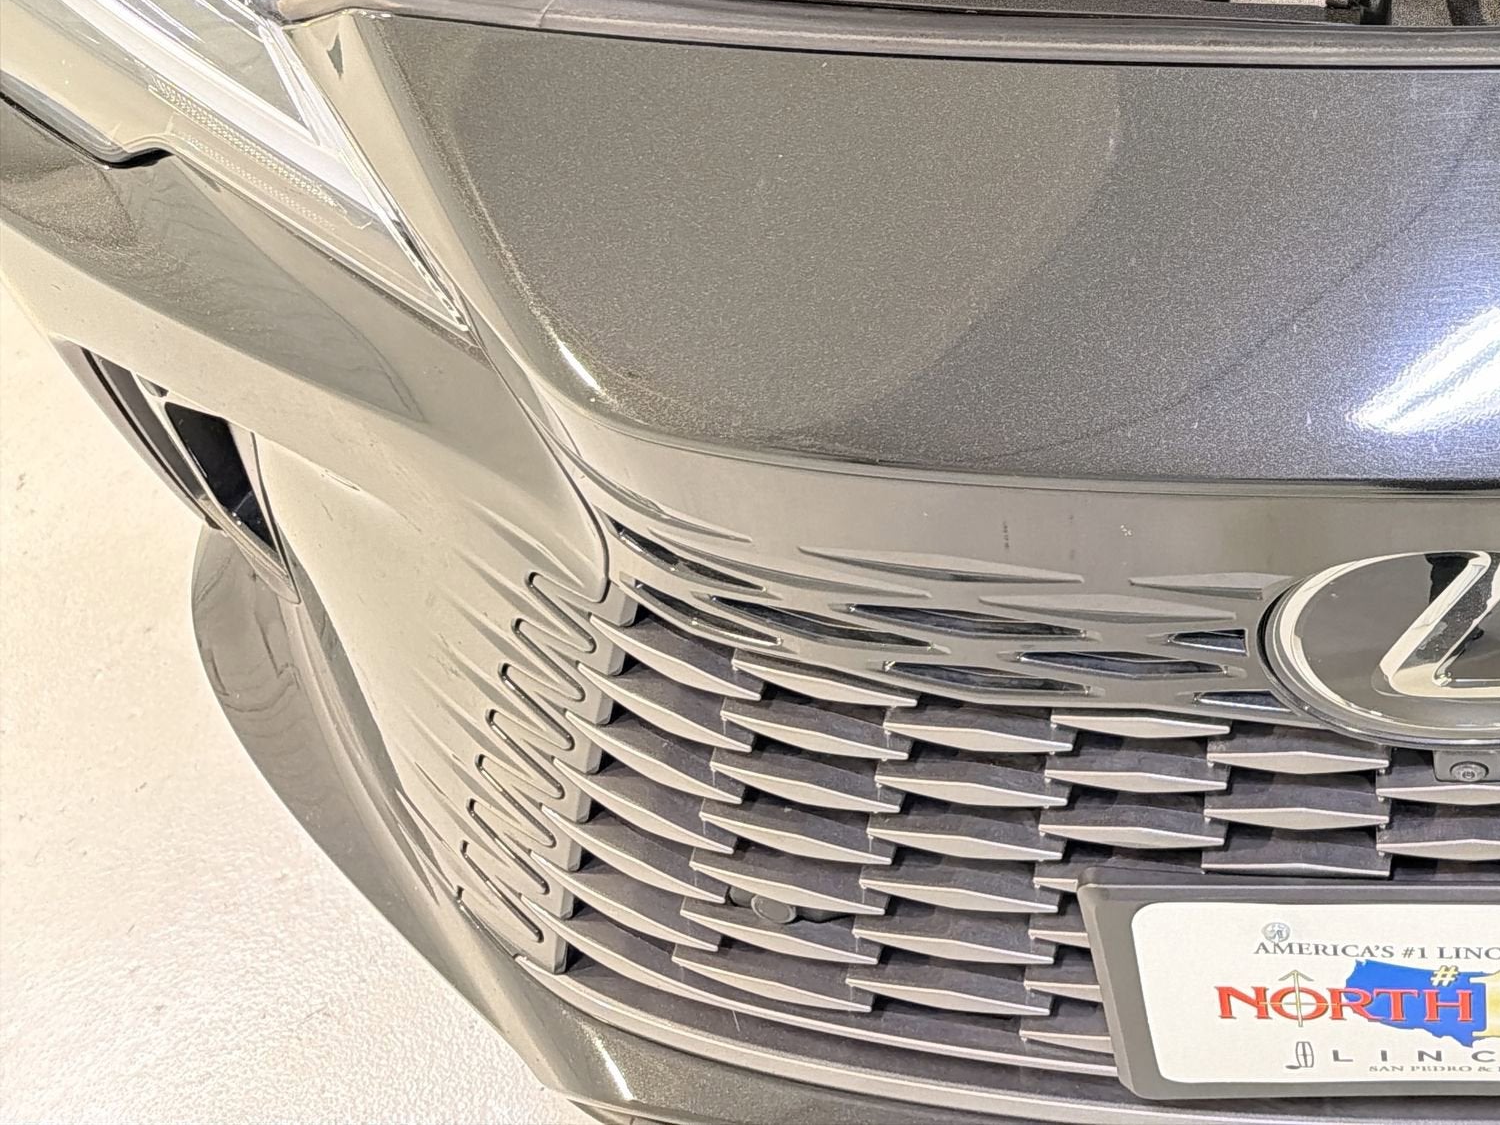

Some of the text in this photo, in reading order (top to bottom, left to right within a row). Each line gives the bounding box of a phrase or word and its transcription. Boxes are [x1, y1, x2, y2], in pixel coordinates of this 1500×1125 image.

[1253, 941, 1395, 959] AMERICA'S
[1401, 946, 1429, 959] #1
[1214, 985, 1473, 1023] NORTH
[1410, 1065, 1472, 1073] PEDRO
